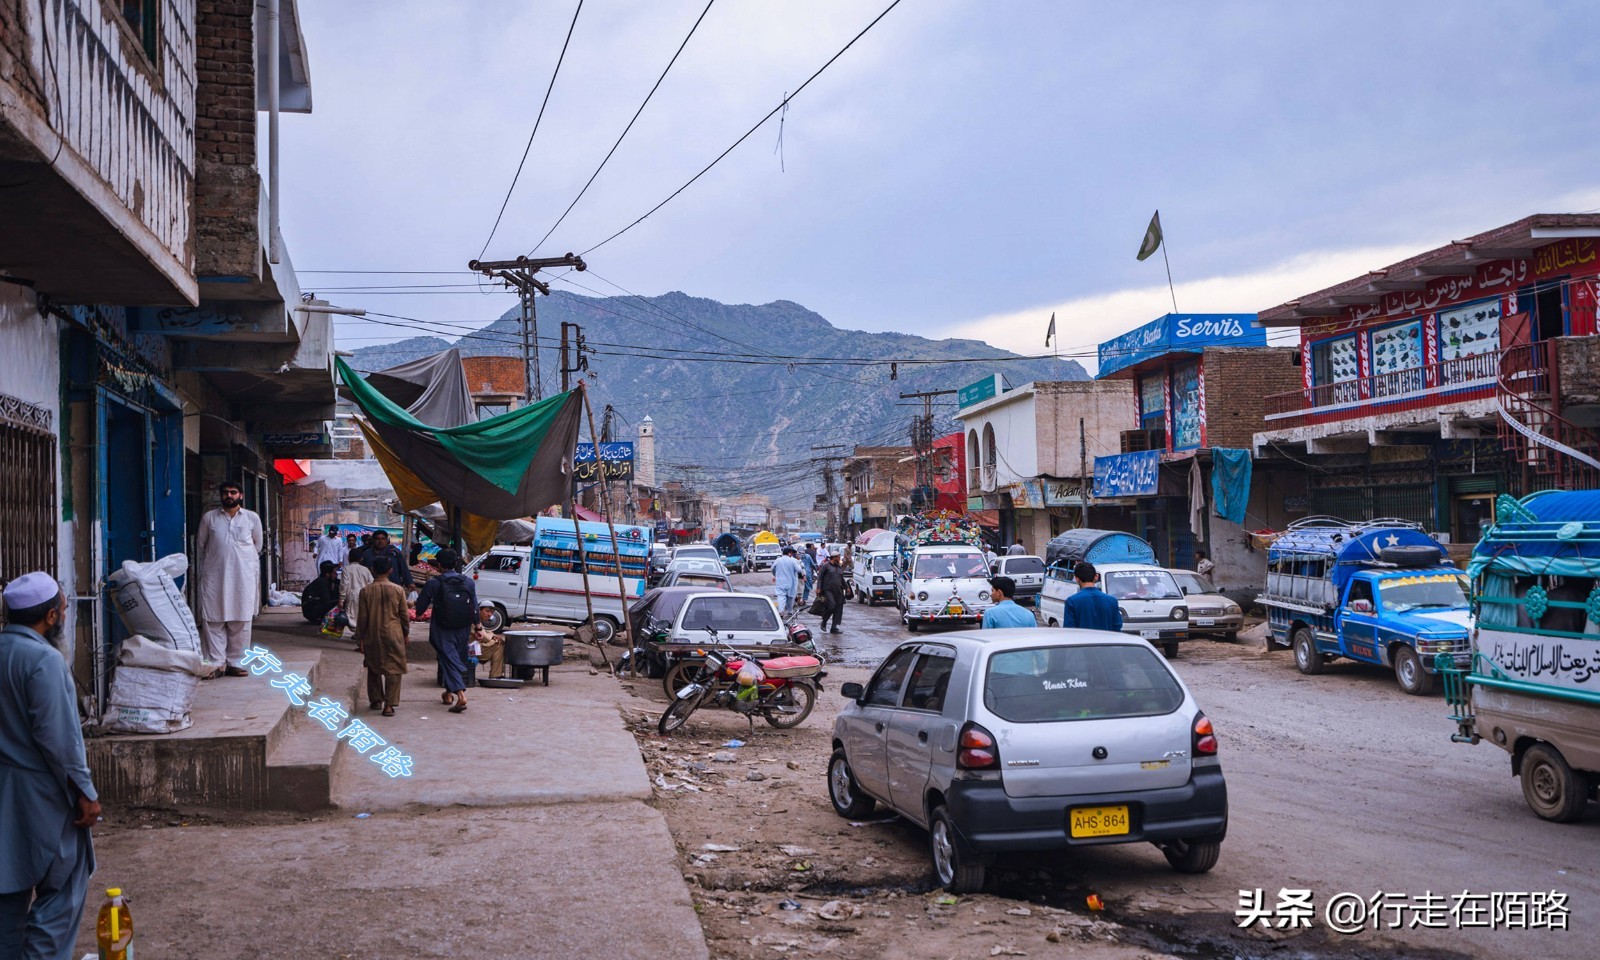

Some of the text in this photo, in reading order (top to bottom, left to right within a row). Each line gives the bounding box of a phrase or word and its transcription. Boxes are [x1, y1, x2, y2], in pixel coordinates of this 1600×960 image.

[1142, 325, 1162, 347] Bata
[1176, 317, 1244, 338] Servis
[538, 539, 558, 548] YOUR
[627, 548, 644, 557] NICE
[1043, 678, 1088, 690] Umair Khan
